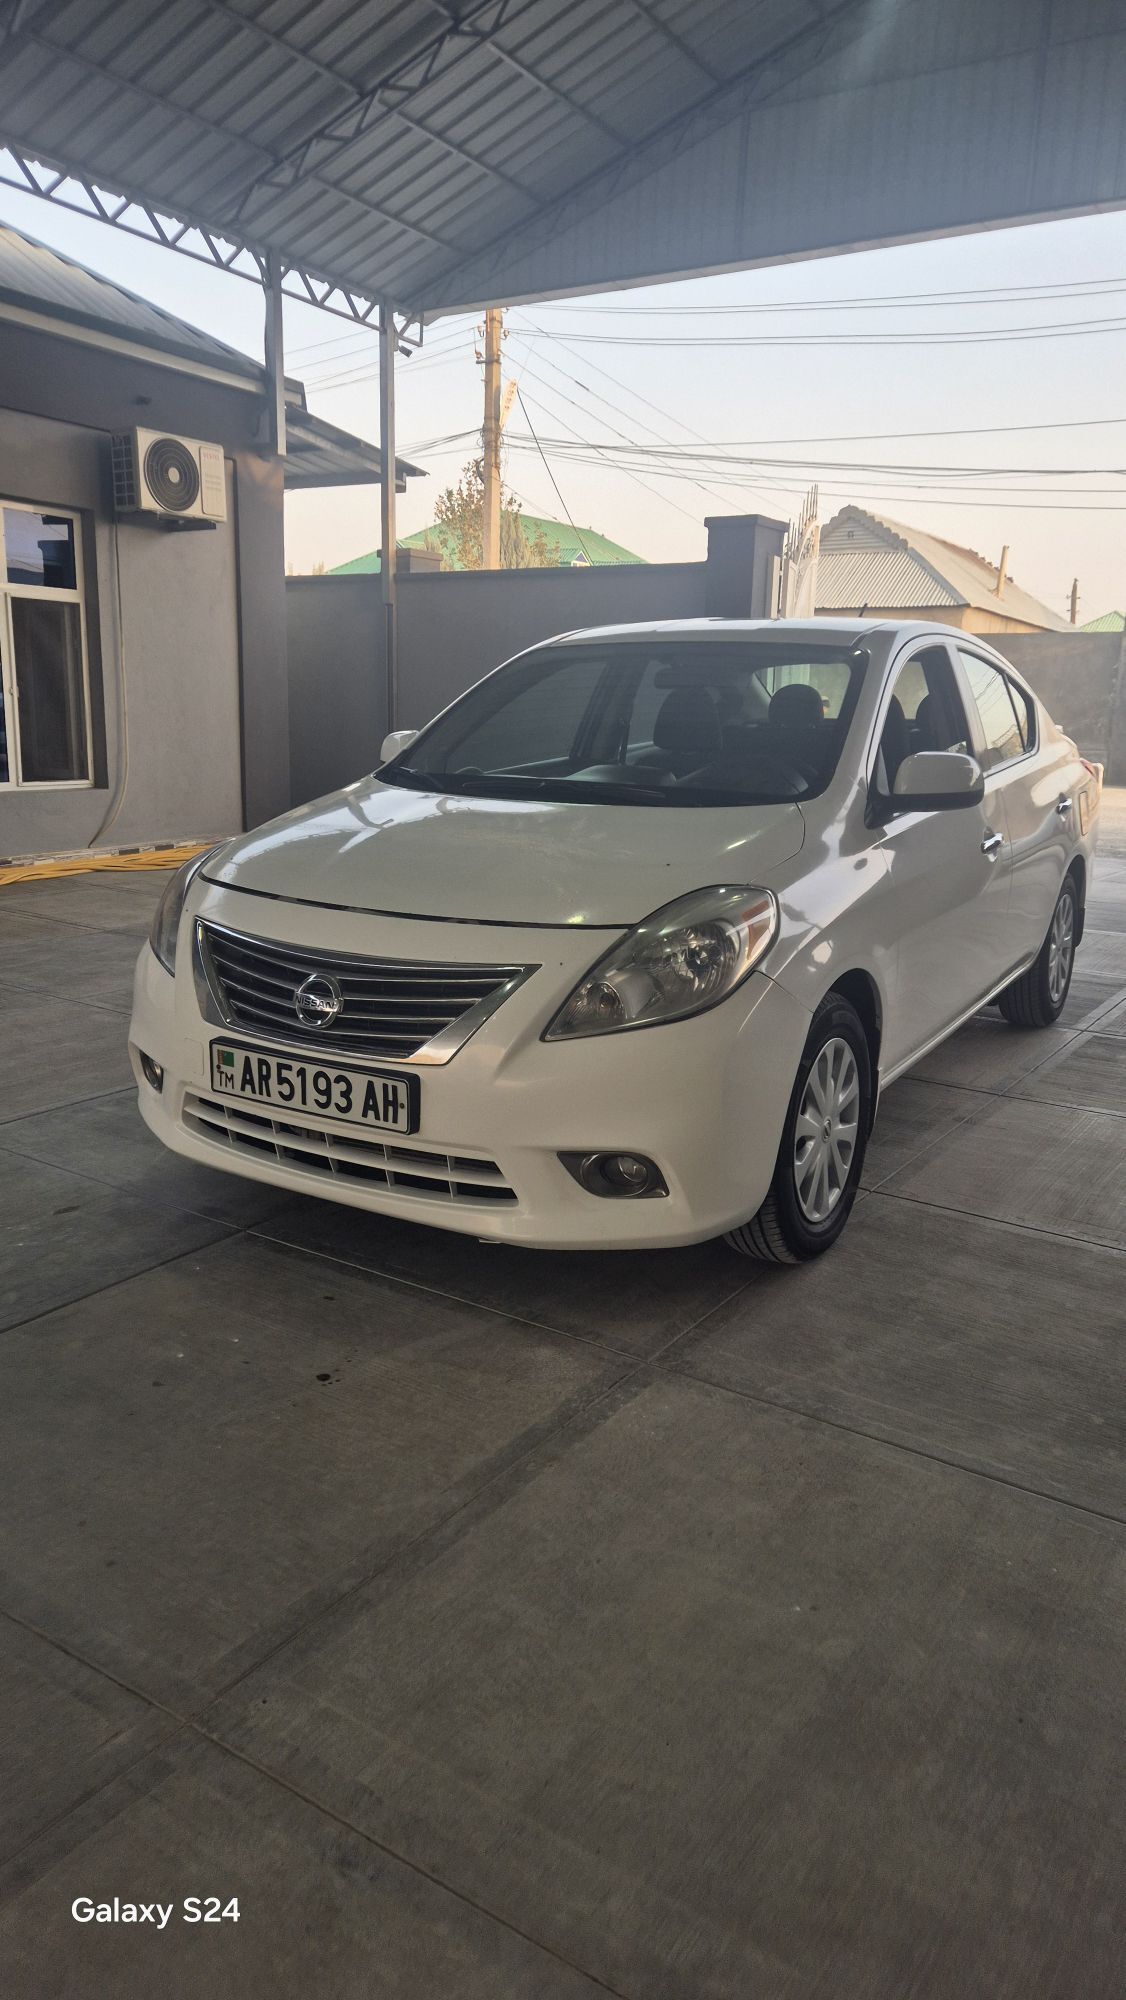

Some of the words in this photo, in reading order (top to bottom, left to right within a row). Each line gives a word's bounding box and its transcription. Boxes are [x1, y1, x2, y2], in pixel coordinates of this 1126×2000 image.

[296, 995, 335, 1009] NISSAN
[217, 1070, 235, 1090] TM
[361, 1080, 399, 1124] AH
